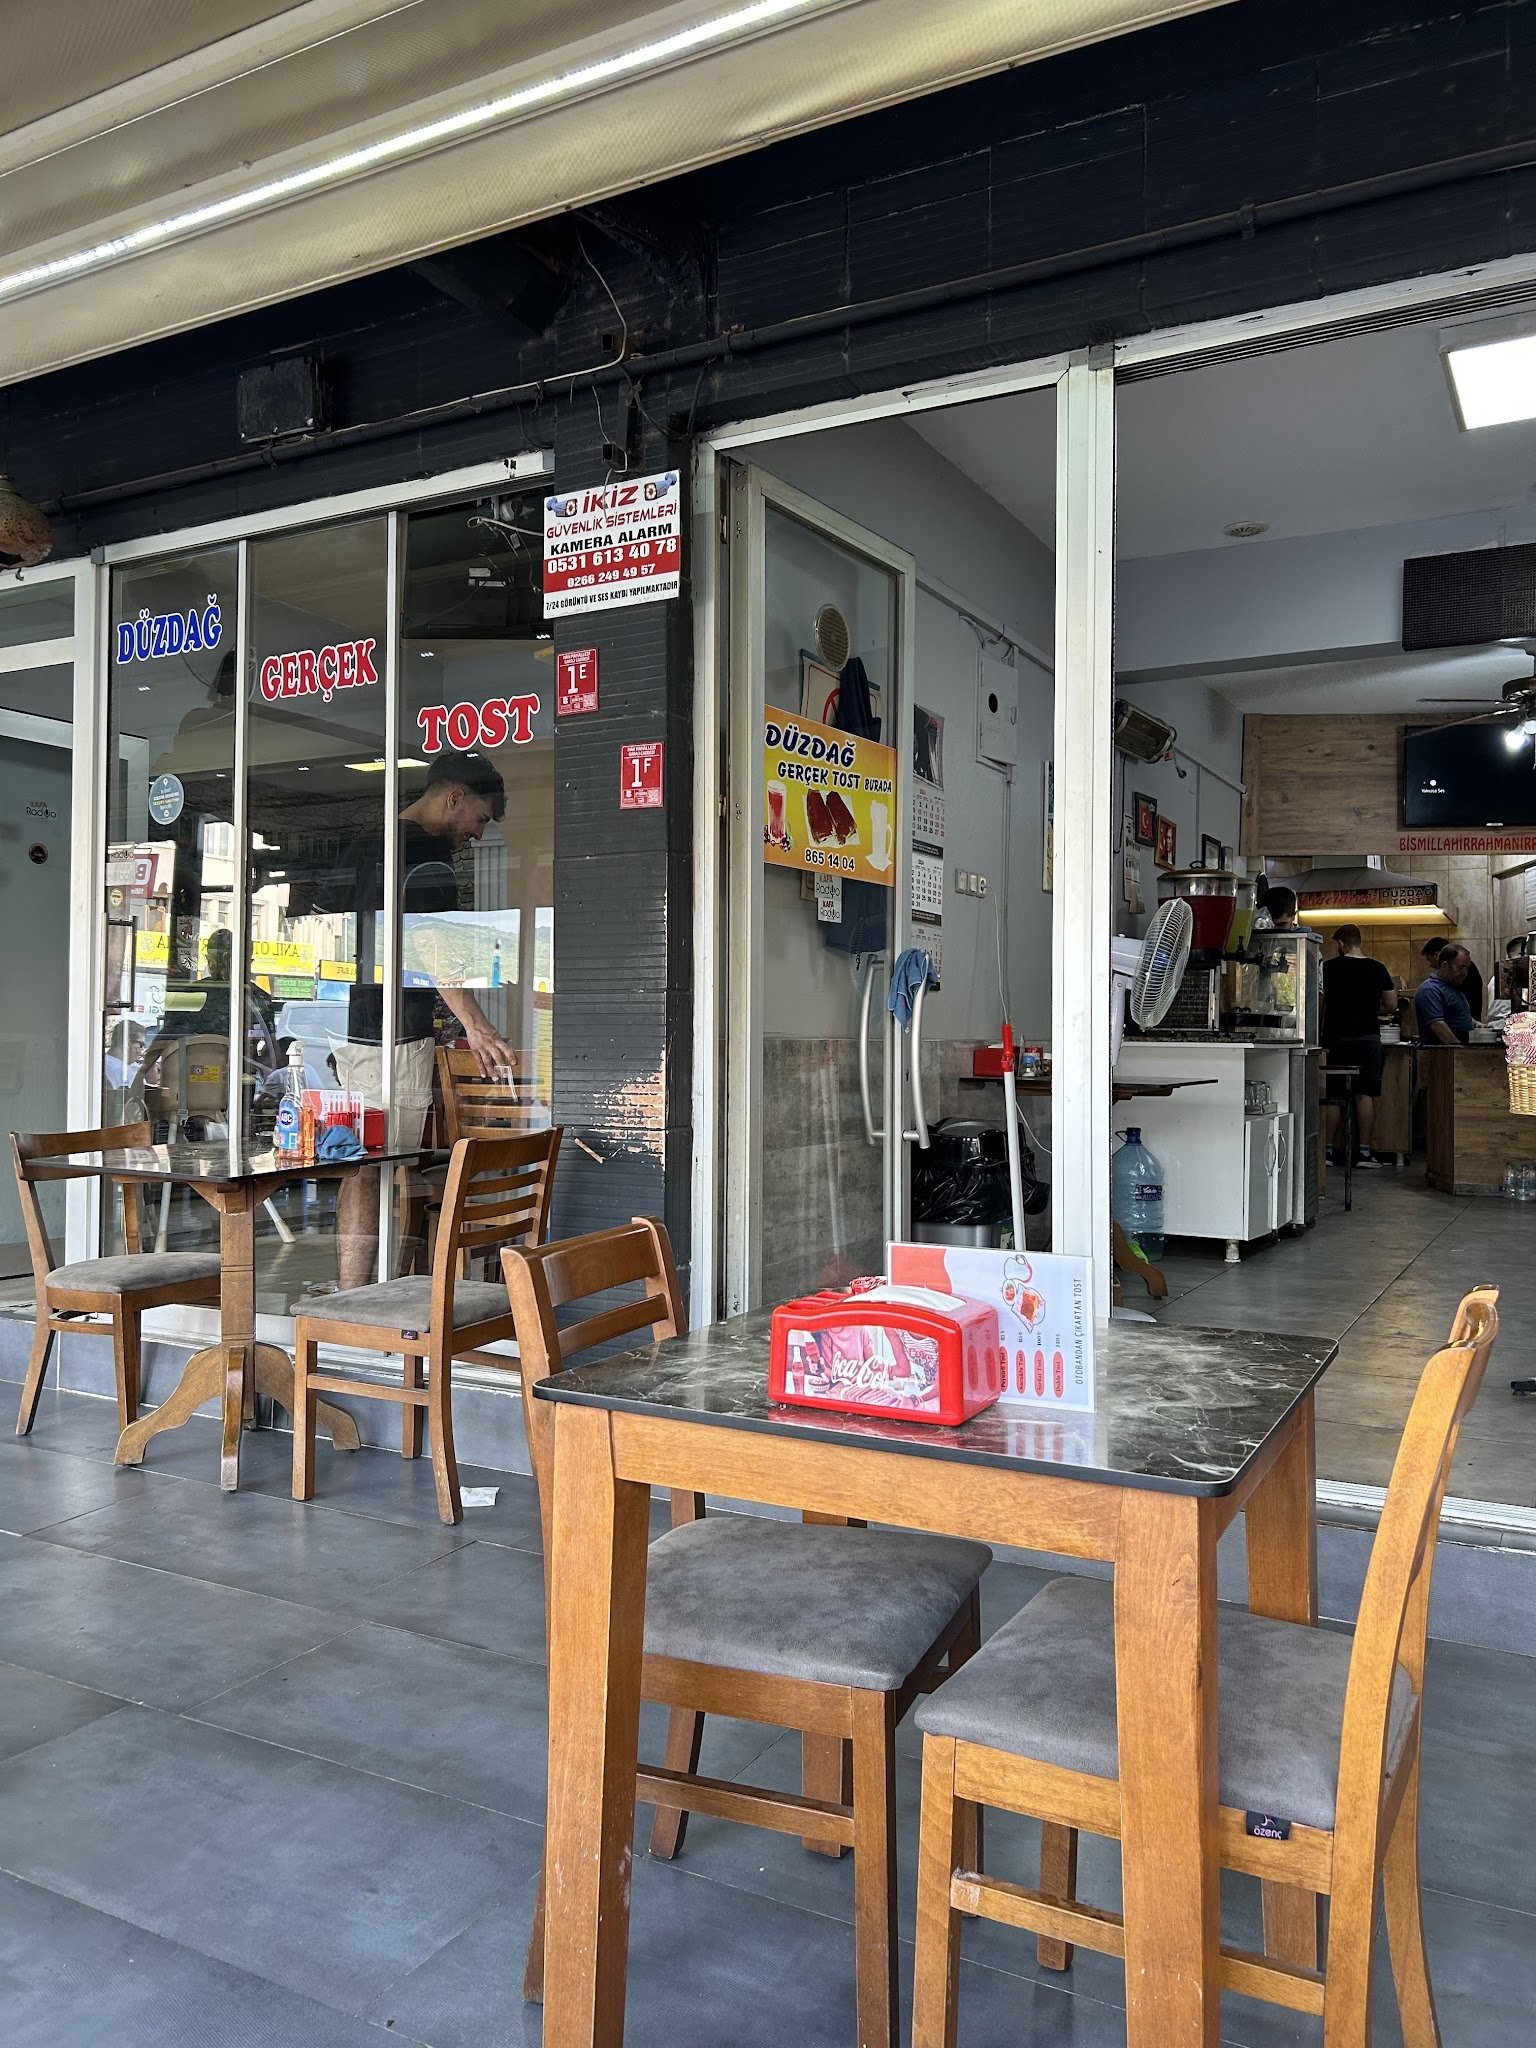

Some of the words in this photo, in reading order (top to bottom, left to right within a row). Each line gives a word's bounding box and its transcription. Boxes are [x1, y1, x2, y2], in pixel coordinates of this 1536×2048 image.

[582, 485, 639, 514] İKİZ
[546, 515, 603, 539] GÜVENLİK
[605, 499, 677, 528] SİSTEMLERİ
[547, 554, 586, 574] 0531
[592, 547, 624, 567] 613
[628, 543, 650, 559] 40
[655, 537, 677, 555] 78
[550, 534, 613, 556] KAMERA
[617, 522, 672, 544] ALARM
[566, 574, 595, 588] 0266
[598, 569, 619, 583] 249
[622, 566, 637, 578] 49
[640, 563, 656, 575] 57
[545, 600, 559, 611] 7/24
[560, 594, 588, 608] GÖRÜNTÜ
[589, 594, 597, 603] VE
[597, 592, 609, 602] SES
[629, 580, 678, 597] YAPILMAKTADIR
[117, 593, 222, 664] DÜZDAĞ
[260, 637, 378, 702] GERÇEK
[417, 693, 540, 753] TOST
[765, 722, 856, 768] DÜZDAĞ
[777, 761, 828, 786] GERÇEK
[832, 770, 860, 790] TOST
[864, 777, 892, 793] BURADA
[805, 849, 824, 865] 865
[827, 854, 839, 868] 14
[842, 856, 855, 871] 04
[1391, 897, 1423, 906] TOST
[280, 1112, 294, 1122] ABC
[1073, 1278, 1083, 1298] TOST
[1074, 1299, 1085, 1337] ÇIKARTAN
[1074, 1339, 1083, 1385] OTOBANDAN
